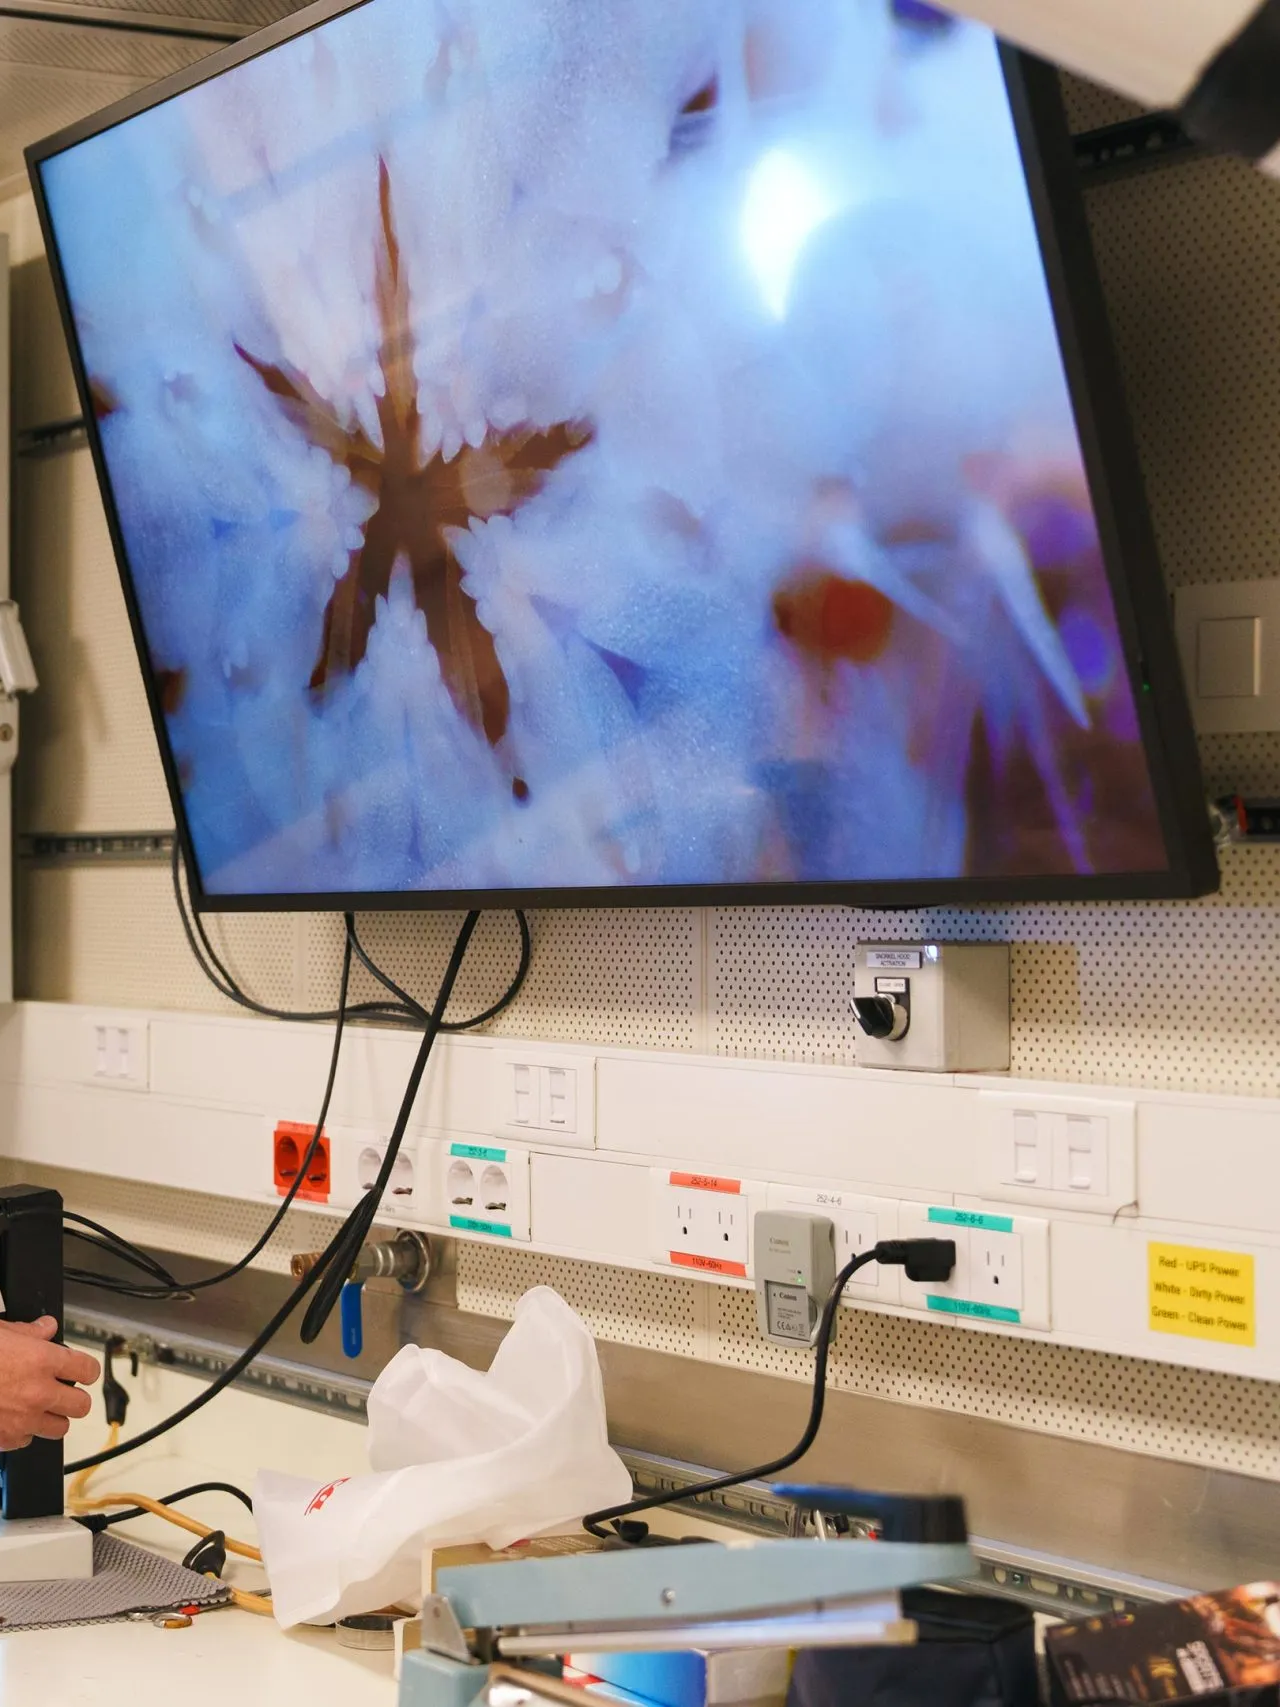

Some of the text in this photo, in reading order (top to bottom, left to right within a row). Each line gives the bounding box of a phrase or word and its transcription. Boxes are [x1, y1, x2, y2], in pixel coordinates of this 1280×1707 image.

[691, 1176, 718, 1187] 252-5-14
[1158, 1256, 1177, 1269] Red
[1185, 1260, 1207, 1273] UPS
[1209, 1262, 1240, 1277] Power
[779, 1292, 797, 1302] Canon
[1154, 1281, 1181, 1295] White
[1189, 1286, 1212, 1302] Dirty
[1214, 1290, 1245, 1305] Power
[1151, 1305, 1180, 1320] Green
[1187, 1311, 1215, 1326] Clean
[1217, 1316, 1248, 1331] Power
